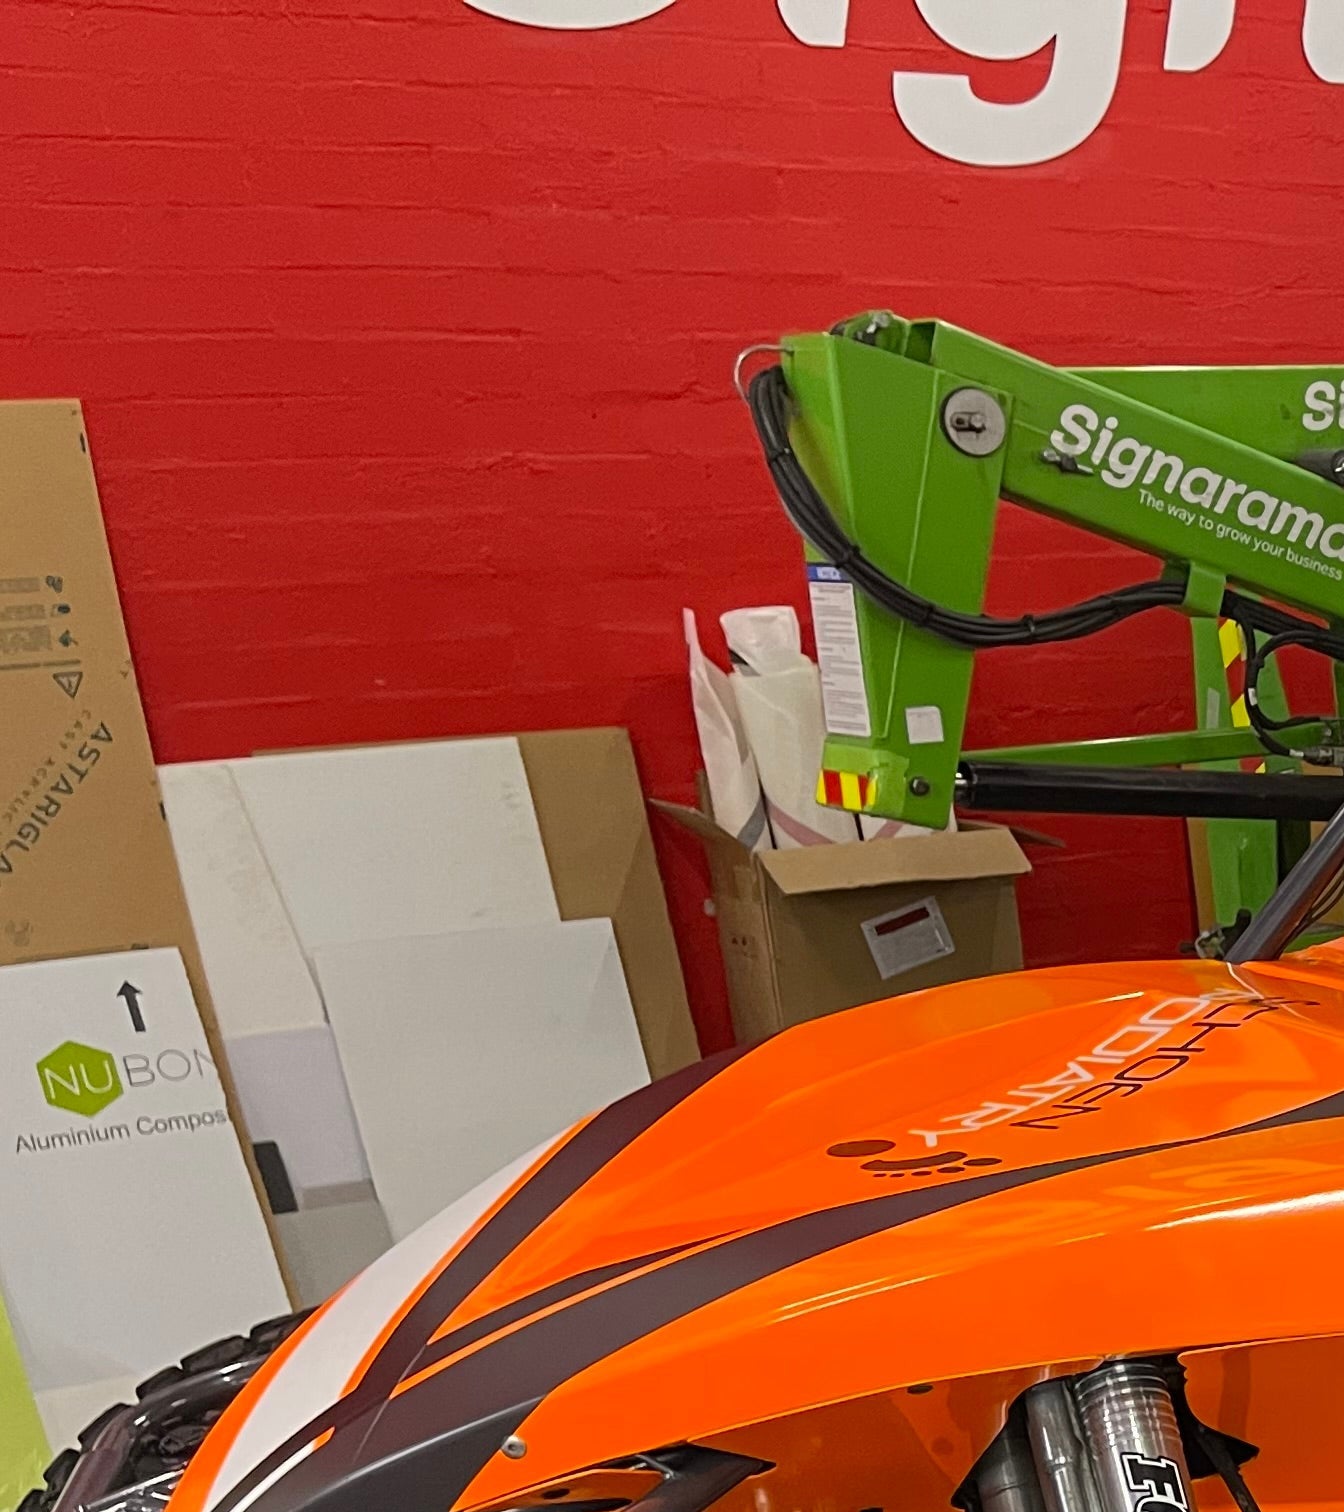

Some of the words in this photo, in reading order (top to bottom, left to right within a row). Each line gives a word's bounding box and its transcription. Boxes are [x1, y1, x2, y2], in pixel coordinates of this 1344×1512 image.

[1138, 488, 1165, 512] The
[1167, 503, 1196, 526] way
[1199, 515, 1215, 531] to
[1216, 522, 1252, 545] grow
[1253, 535, 1286, 558] your
[1286, 547, 1344, 582] business
[16, 1122, 131, 1155] Aluminium
